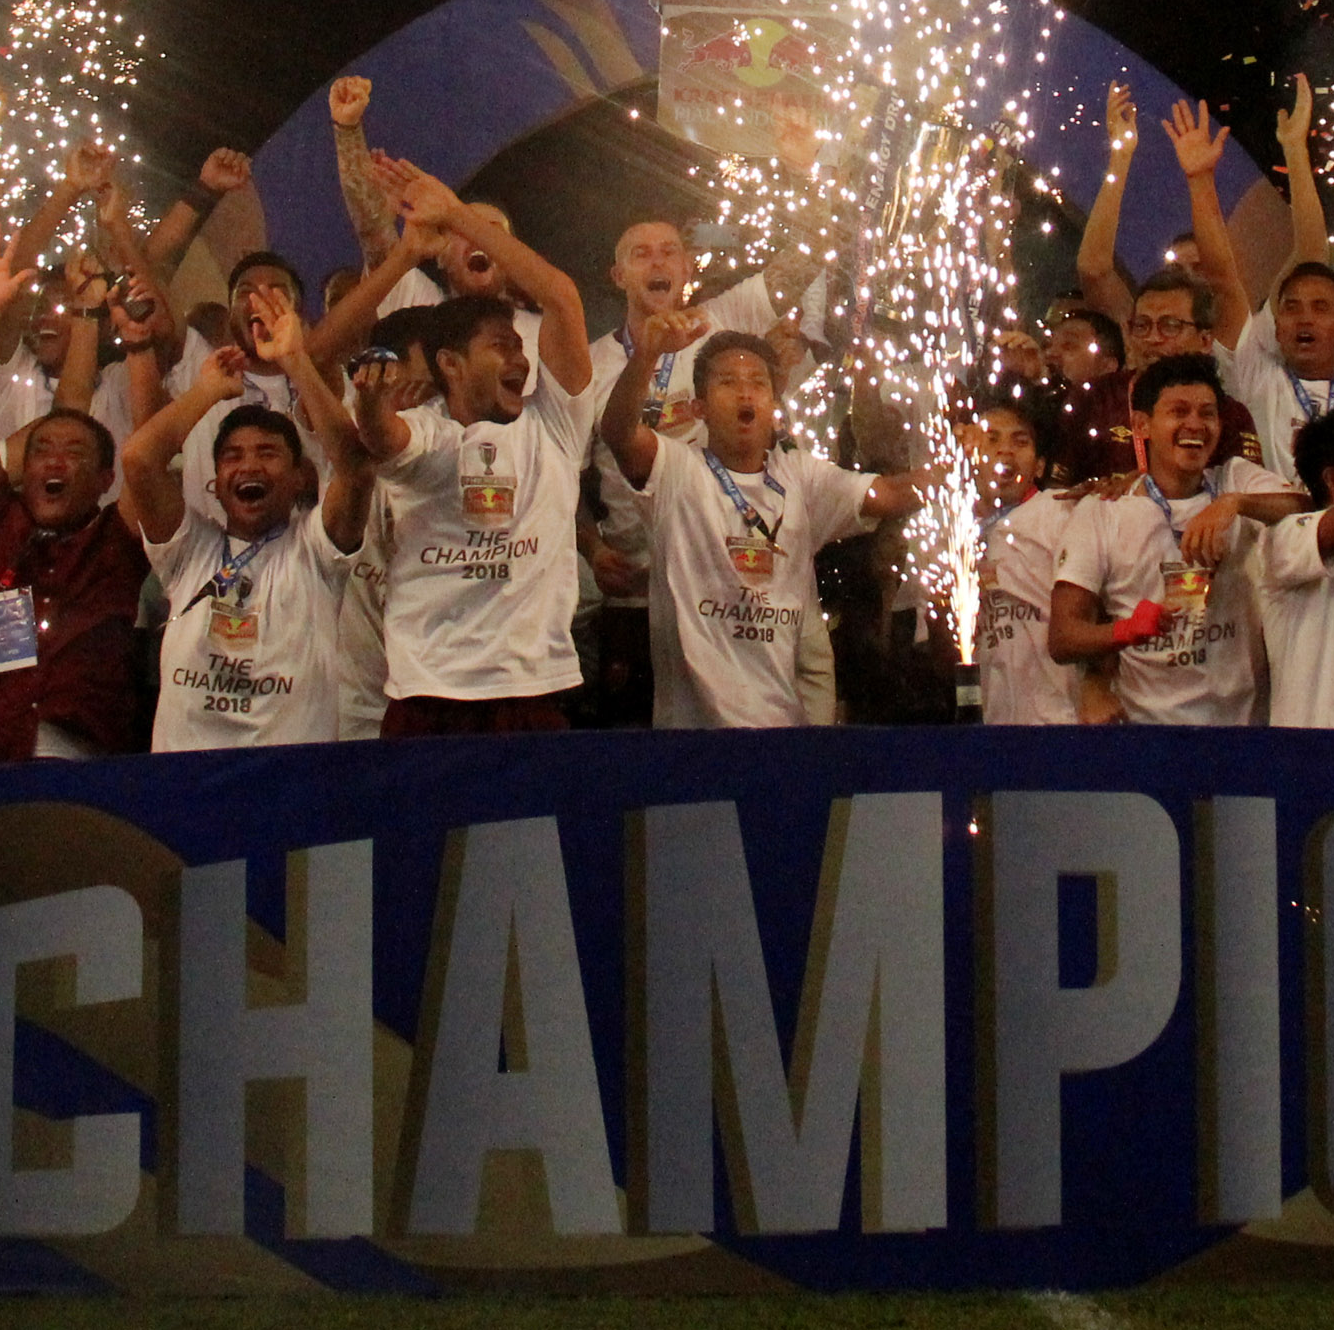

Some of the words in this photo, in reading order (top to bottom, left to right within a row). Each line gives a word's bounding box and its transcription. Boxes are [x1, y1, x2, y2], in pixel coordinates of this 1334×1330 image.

[466, 530, 510, 549] THE
[420, 537, 539, 565] CHAMPION
[462, 565, 510, 581] 2018
[740, 586, 771, 605] THE
[699, 600, 800, 626] CHAMPION
[733, 626, 774, 644] 2018
[208, 654, 253, 677] THE
[1168, 650, 1207, 667] 2018
[173, 668, 294, 695] CHAMPION
[204, 697, 252, 714] 2018
